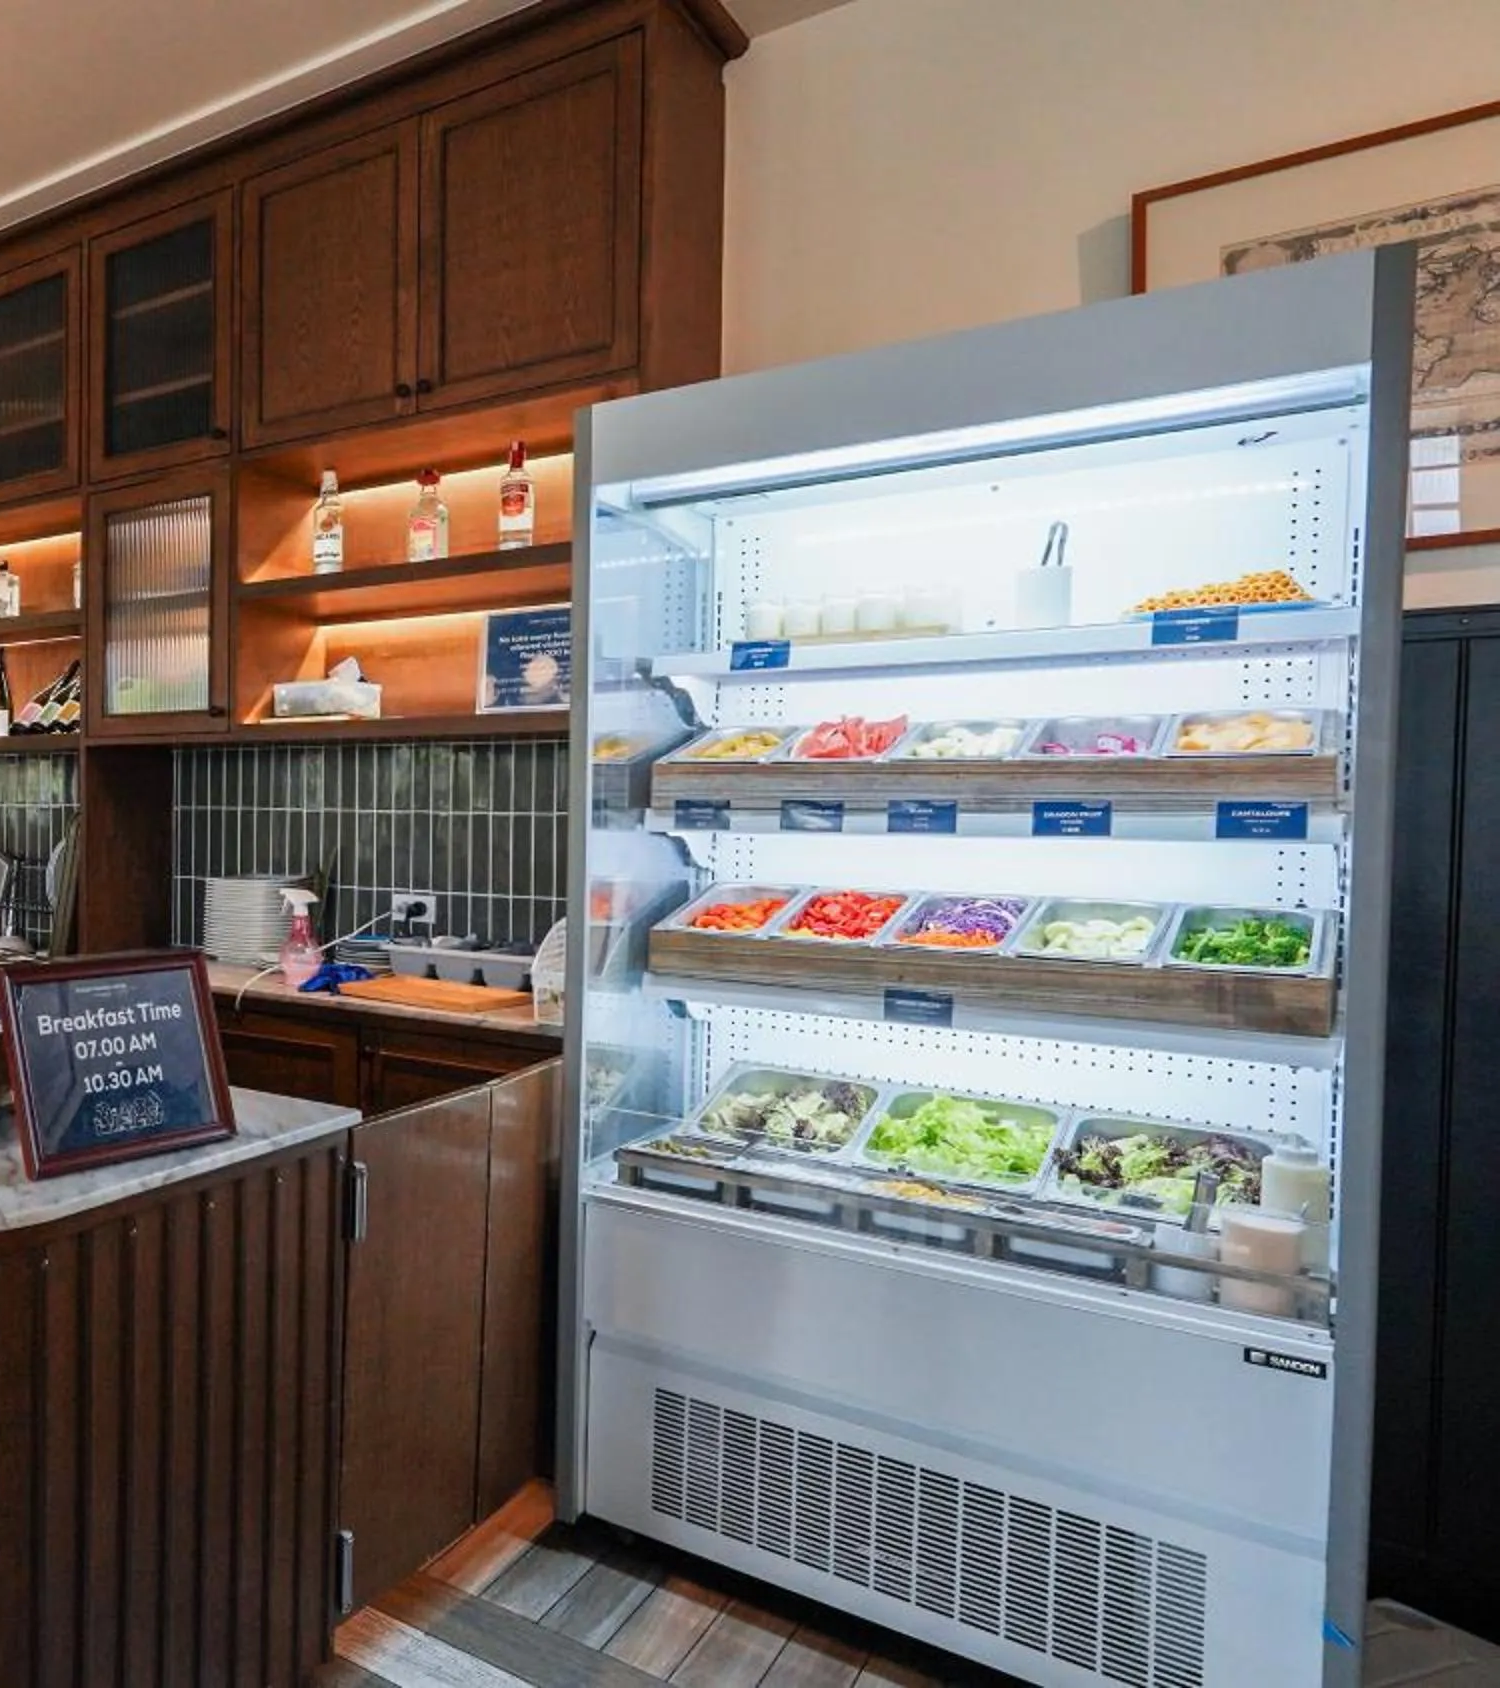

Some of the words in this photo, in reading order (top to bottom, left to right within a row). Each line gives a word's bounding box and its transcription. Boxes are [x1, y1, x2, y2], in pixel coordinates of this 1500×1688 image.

[37, 1006, 136, 1036] Breakfast
[135, 1002, 182, 1022] Time
[74, 1036, 125, 1060] 07.00
[129, 1031, 157, 1053] AM
[83, 1069, 132, 1094] 10.30
[135, 1064, 163, 1085] AM
[1269, 1355, 1320, 1375] SANDEN
